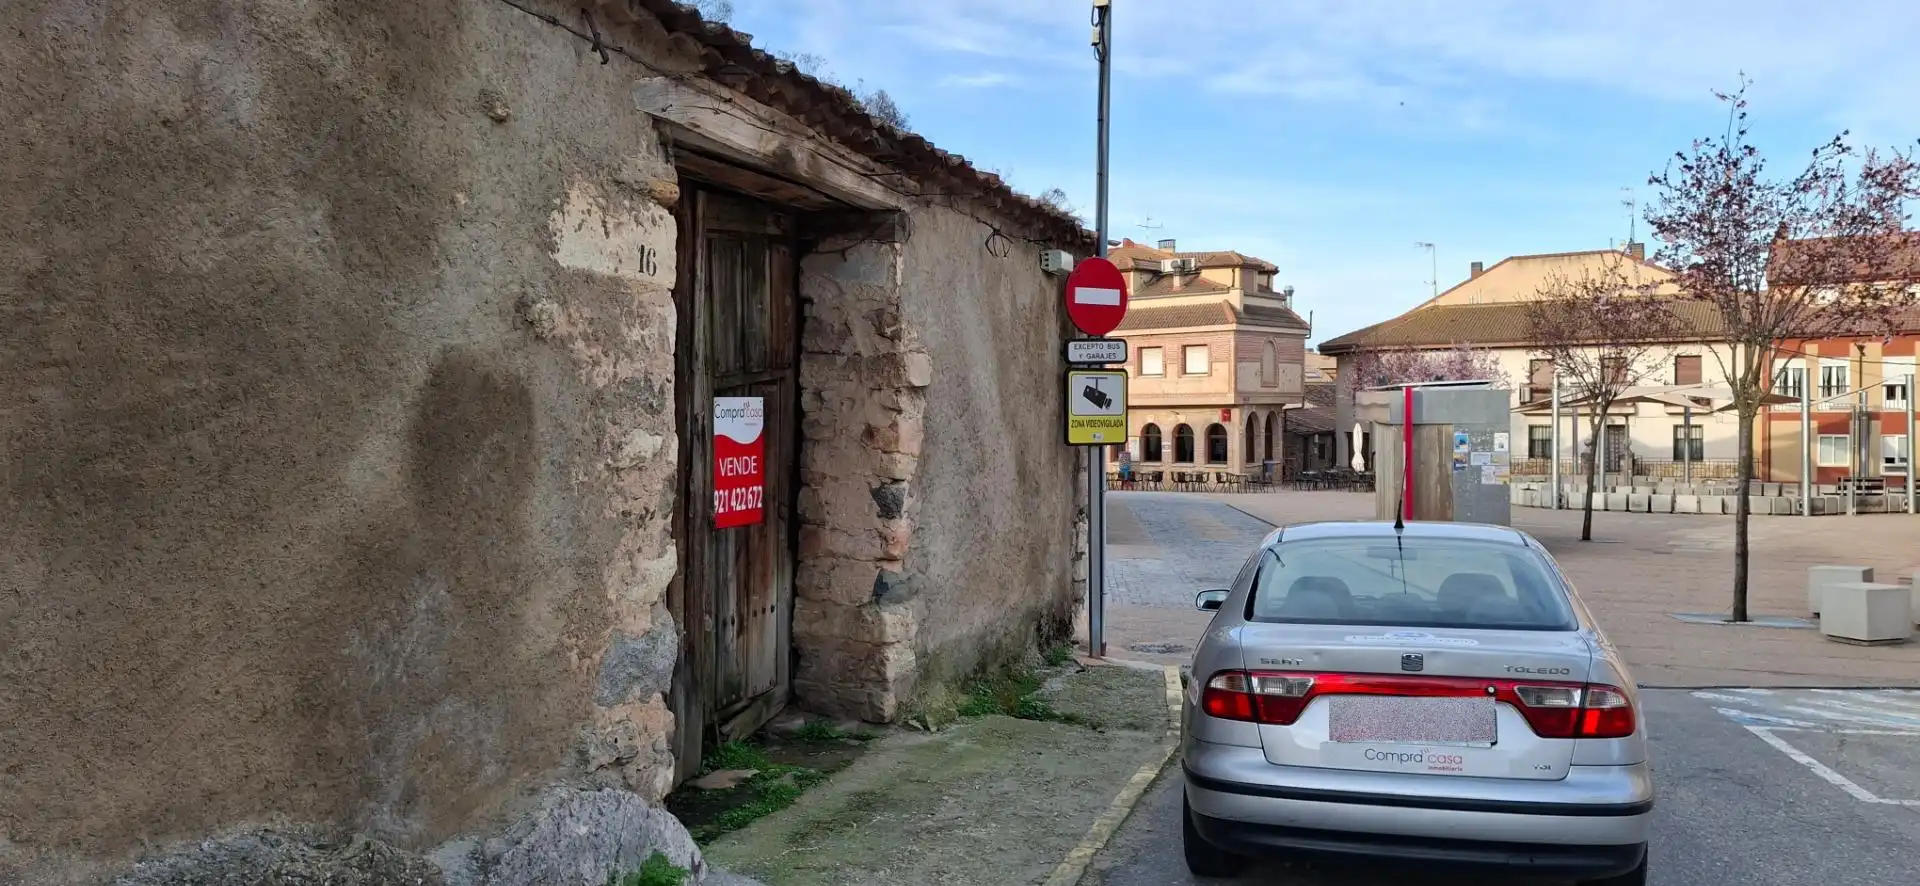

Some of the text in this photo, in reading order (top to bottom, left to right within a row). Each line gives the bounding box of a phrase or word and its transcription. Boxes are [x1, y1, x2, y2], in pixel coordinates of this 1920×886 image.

[637, 244, 657, 277] 16
[1074, 342, 1121, 350] EXCEPTO BUS
[1086, 352, 1117, 360] GARAJES
[714, 403, 744, 423] Compra
[745, 408, 763, 418] casa
[1071, 419, 1124, 428] ZONA VIDEOVIGILADA
[719, 455, 758, 477] VENDE
[714, 486, 763, 514] 921 422 672
[1260, 657, 1304, 666] SEAT
[1503, 664, 1570, 675] TOLEDO
[1364, 748, 1423, 765] Compra
[1428, 754, 1463, 765] casa
